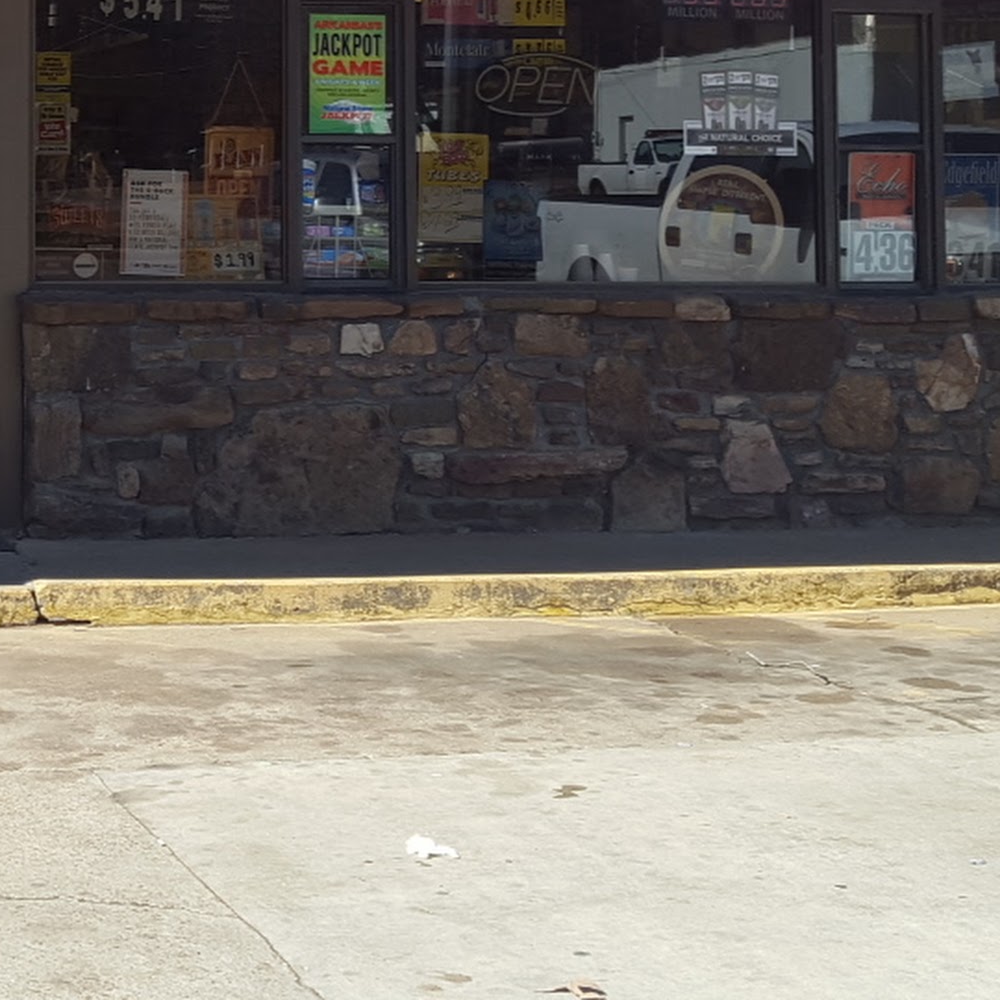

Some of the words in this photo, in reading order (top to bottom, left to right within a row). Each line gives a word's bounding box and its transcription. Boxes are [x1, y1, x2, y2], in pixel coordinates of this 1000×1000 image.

[667, 6, 718, 19] MILLION
[735, 8, 785, 21] MILLION
[312, 32, 383, 57] JACKPOT
[312, 59, 384, 76] GAME
[476, 64, 594, 106] OPEN
[710, 132, 750, 142] NATURAL
[751, 134, 783, 143] CHOICE
[426, 170, 482, 183] TUBES
